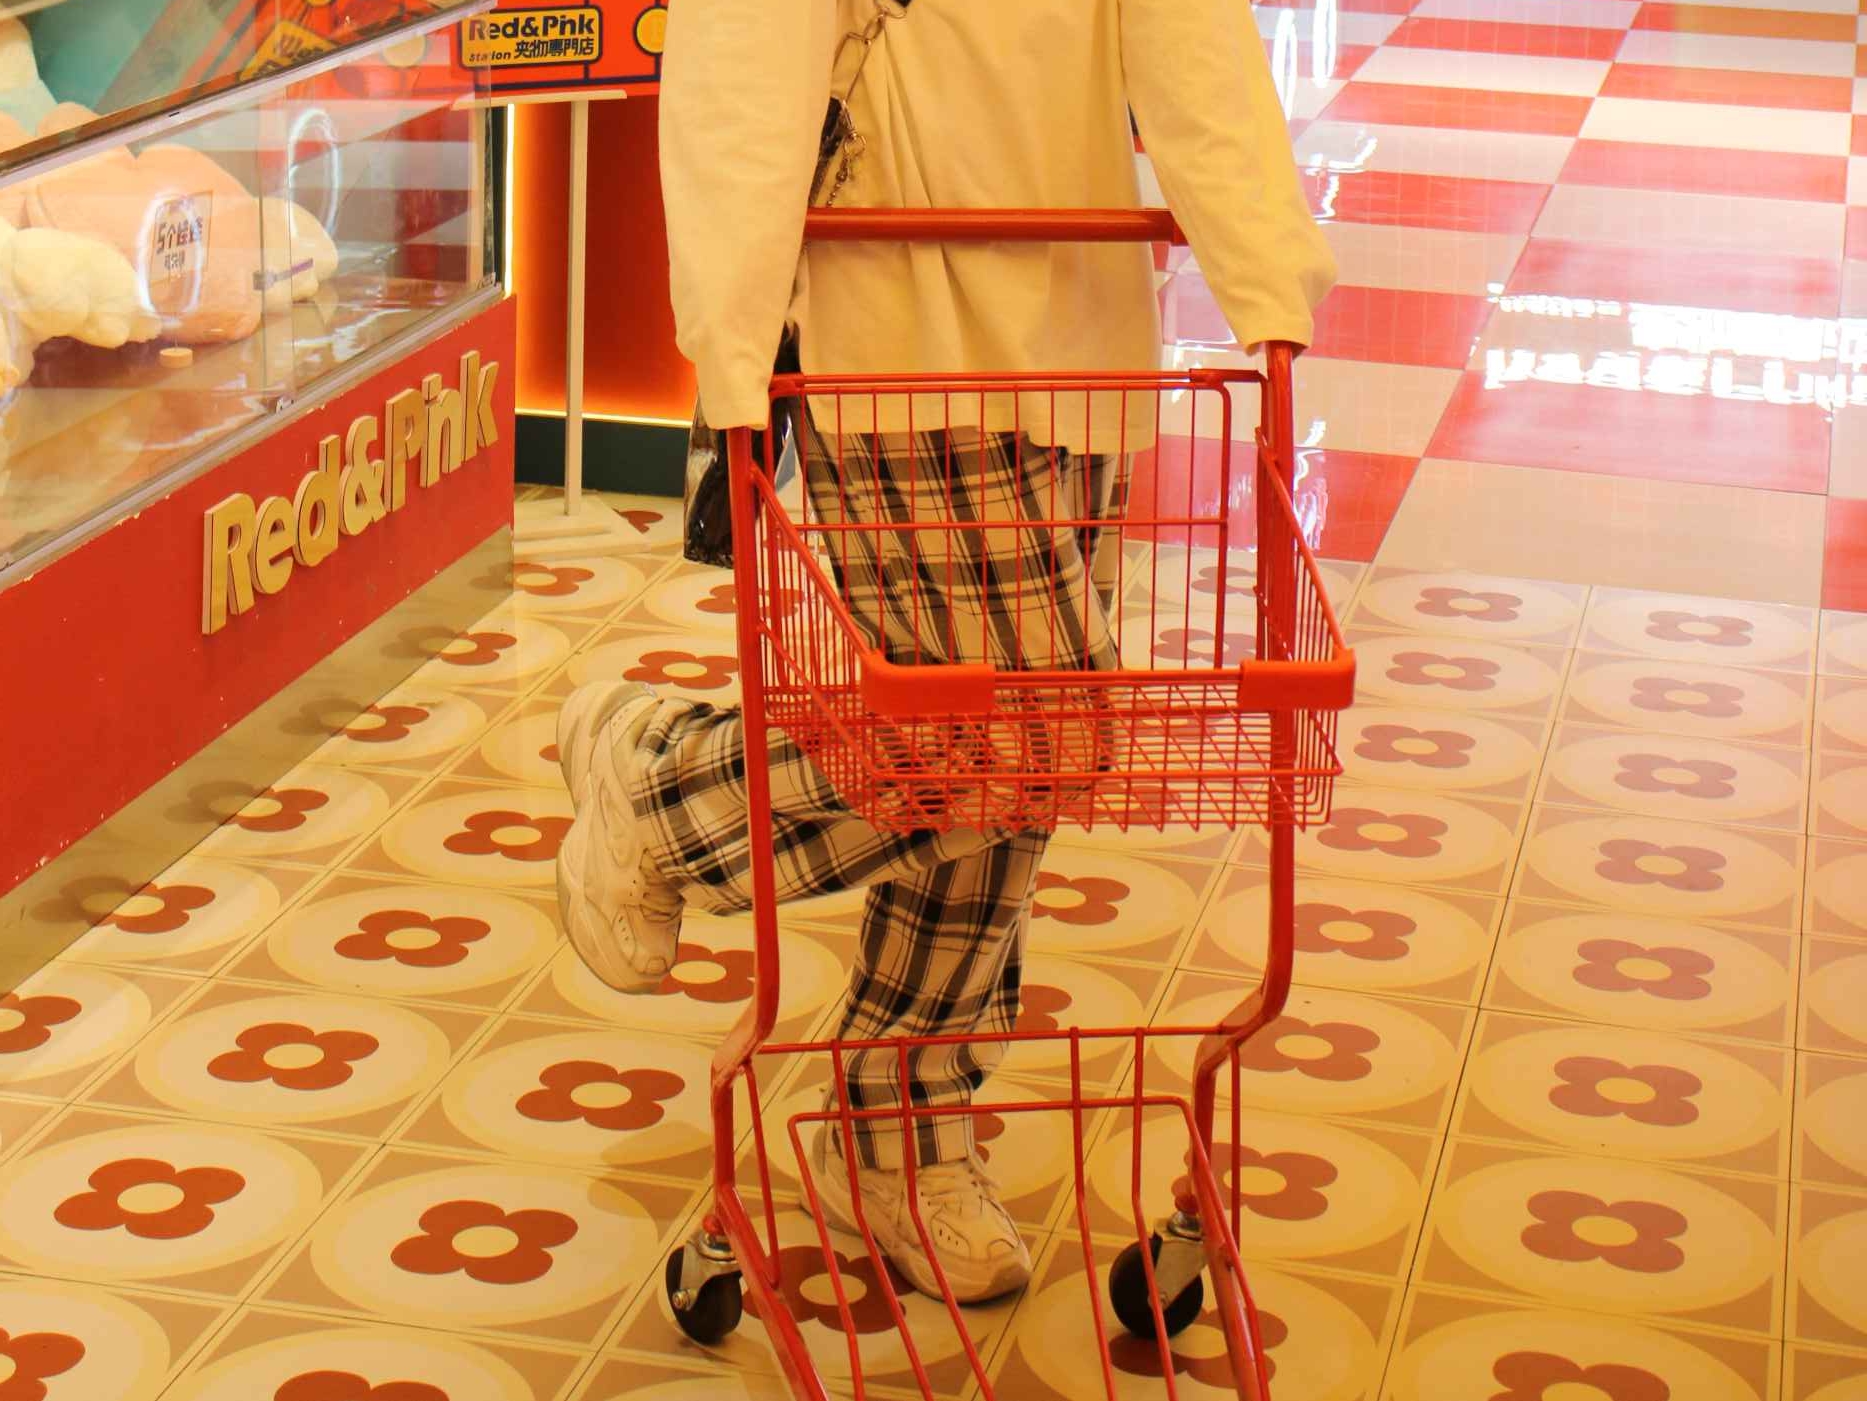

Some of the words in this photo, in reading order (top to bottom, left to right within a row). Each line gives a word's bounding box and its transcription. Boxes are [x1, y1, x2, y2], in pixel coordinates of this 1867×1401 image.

[468, 14, 595, 41] Red&Pink
[468, 50, 511, 63] staion
[201, 350, 499, 635] Red&Pink
